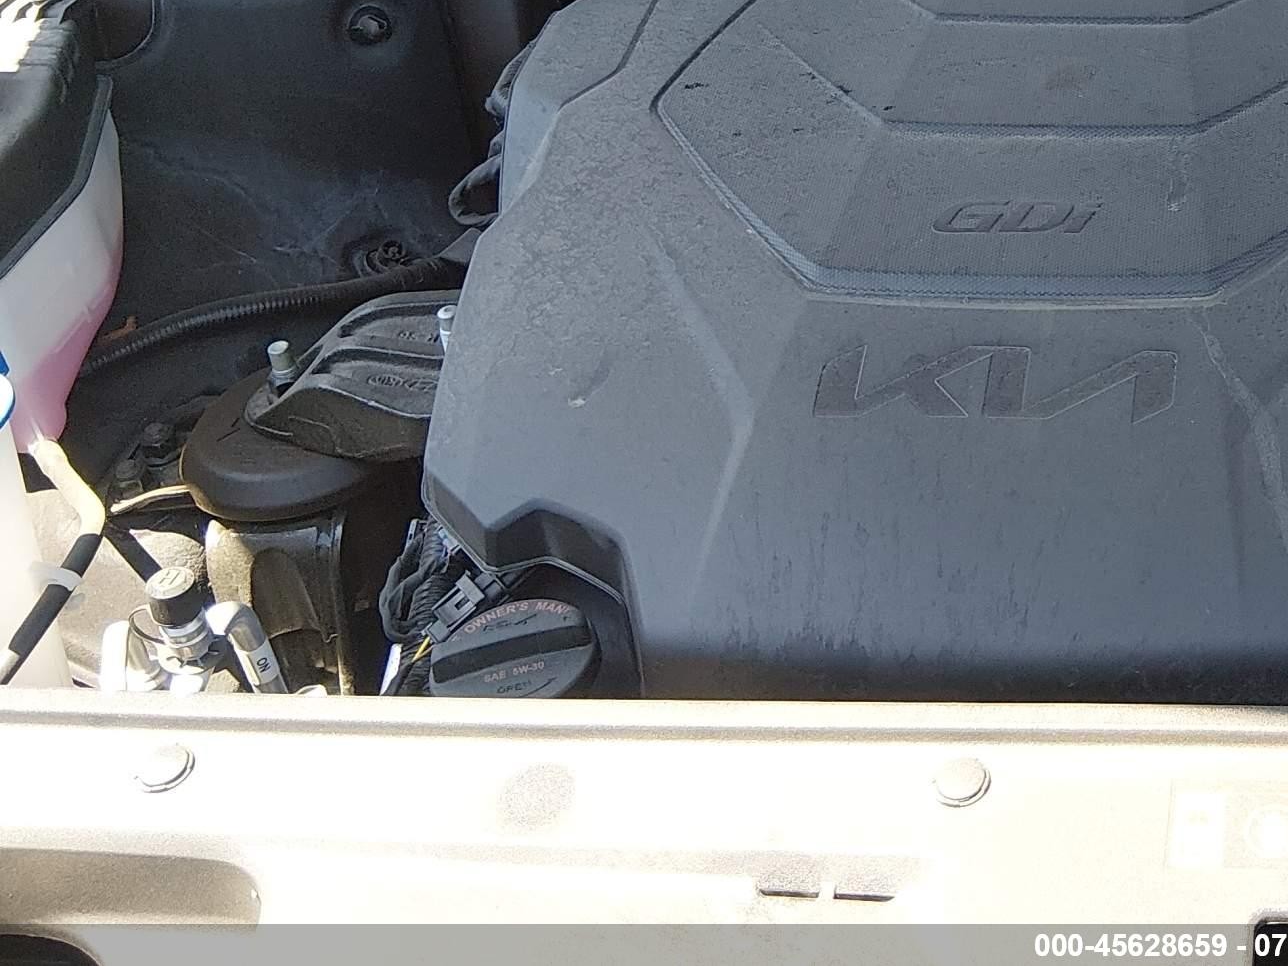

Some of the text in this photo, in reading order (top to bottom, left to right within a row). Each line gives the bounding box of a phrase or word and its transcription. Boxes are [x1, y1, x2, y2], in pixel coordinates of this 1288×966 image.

[812, 344, 1179, 425] KIA
[463, 601, 529, 634] OWNER'S
[484, 661, 545, 683] SAE 5W-30
